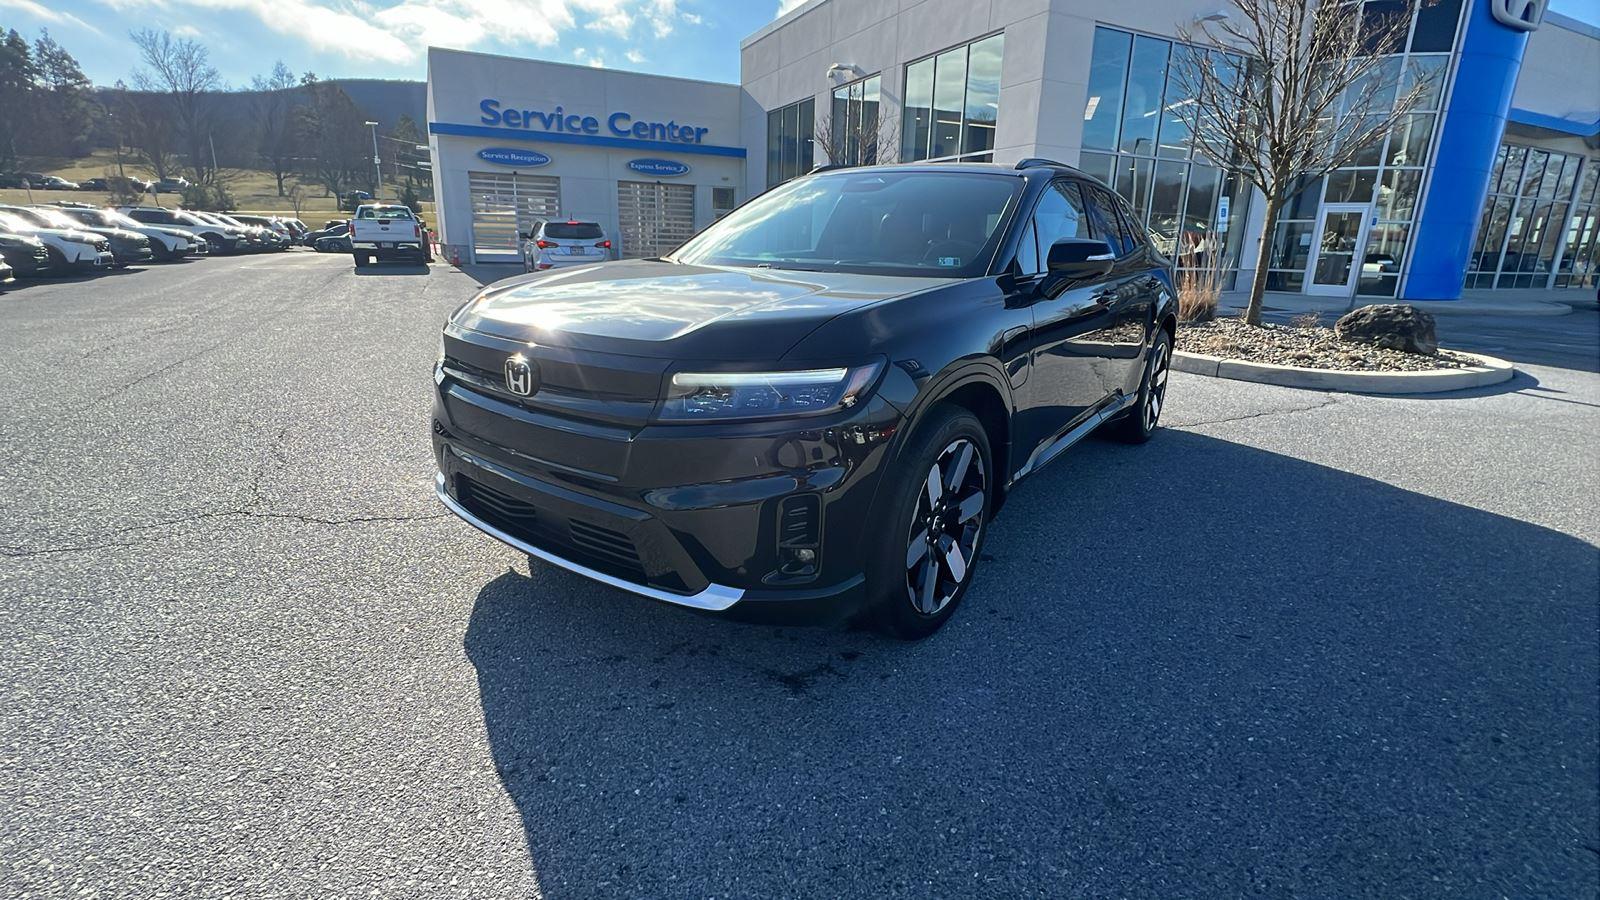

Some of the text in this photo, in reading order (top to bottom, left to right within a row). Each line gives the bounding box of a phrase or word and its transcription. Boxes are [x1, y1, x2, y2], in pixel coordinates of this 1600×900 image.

[480, 99, 708, 143] Service Center
[481, 151, 547, 163] Service Reception
[630, 162, 654, 170] Express
